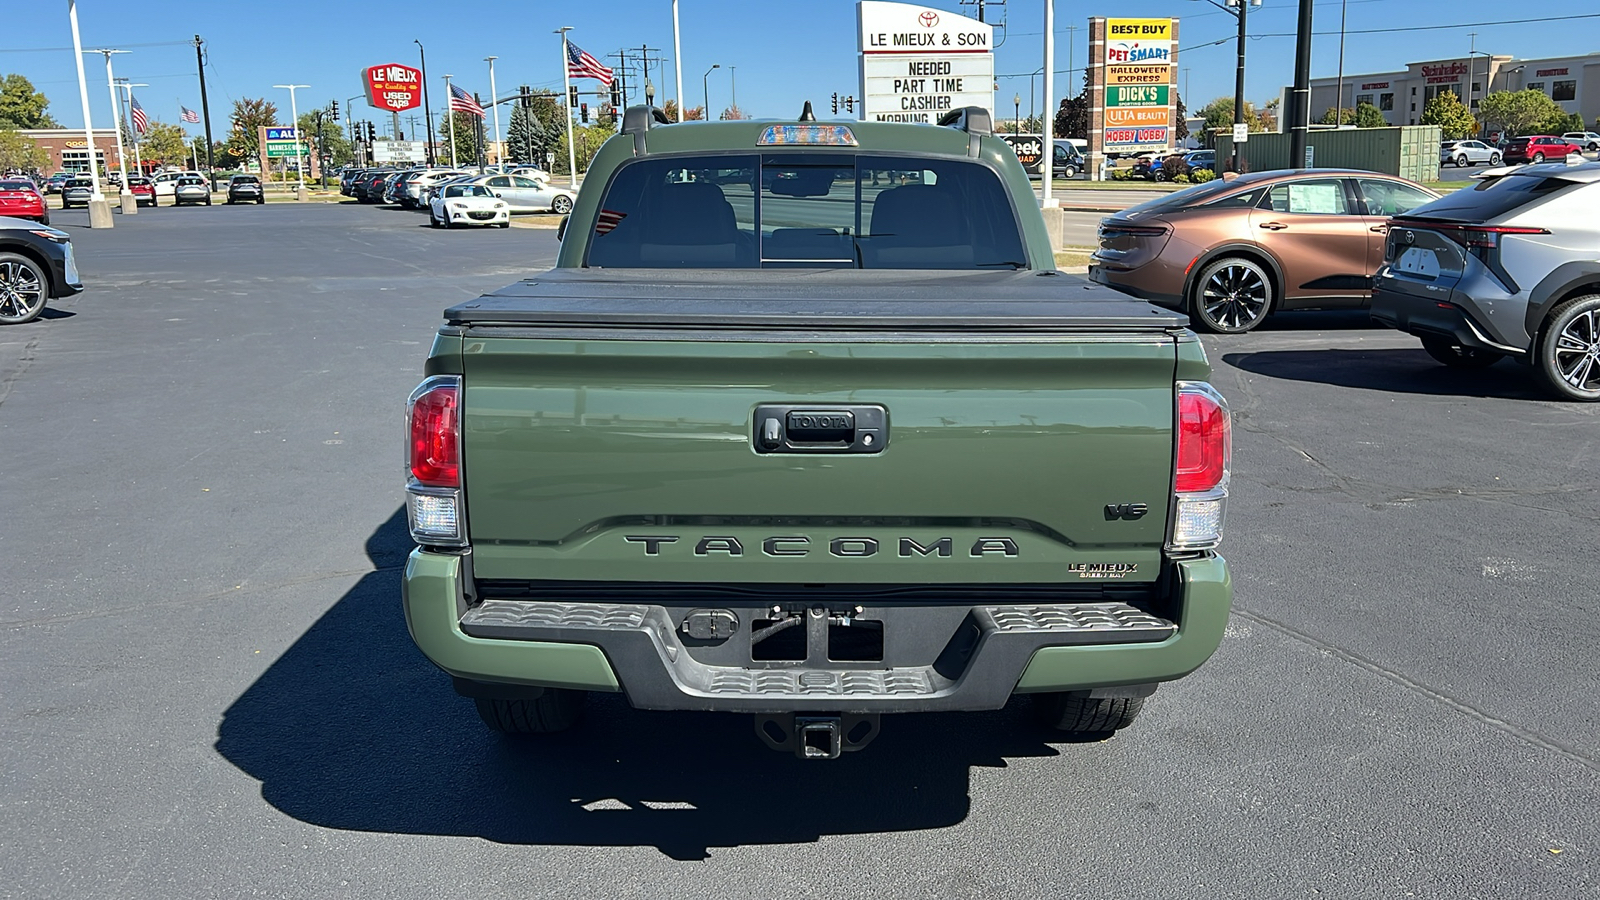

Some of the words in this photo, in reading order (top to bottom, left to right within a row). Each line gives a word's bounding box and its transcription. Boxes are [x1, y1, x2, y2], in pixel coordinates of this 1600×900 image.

[1111, 25, 1140, 34] BEST
[1142, 25, 1167, 34] BUY
[870, 33, 887, 46] LE
[893, 33, 935, 46] MIEUX
[941, 33, 951, 46] &
[957, 33, 986, 46] SON
[372, 69, 385, 81] LE
[386, 66, 417, 83] MIEUX
[909, 61, 951, 75] NEEDED
[1421, 62, 1468, 77] Steinhafels
[894, 78, 926, 93] PART
[933, 78, 963, 92] TIME
[383, 91, 412, 100] USED
[1118, 86, 1158, 102] DICK'S
[386, 99, 409, 109] CARS
[901, 95, 951, 110] CASHIER
[1109, 110, 1135, 121] ULTA
[1137, 111, 1167, 120] BEAUTY
[1106, 130, 1136, 142] HOBBY
[1138, 129, 1166, 142] LOBBY
[791, 415, 850, 428] TOYOTA
[1104, 502, 1148, 521] V6
[623, 535, 1020, 557] TACOMA
[1068, 563, 1087, 573] LE
[1088, 563, 1138, 573] MIEUX
